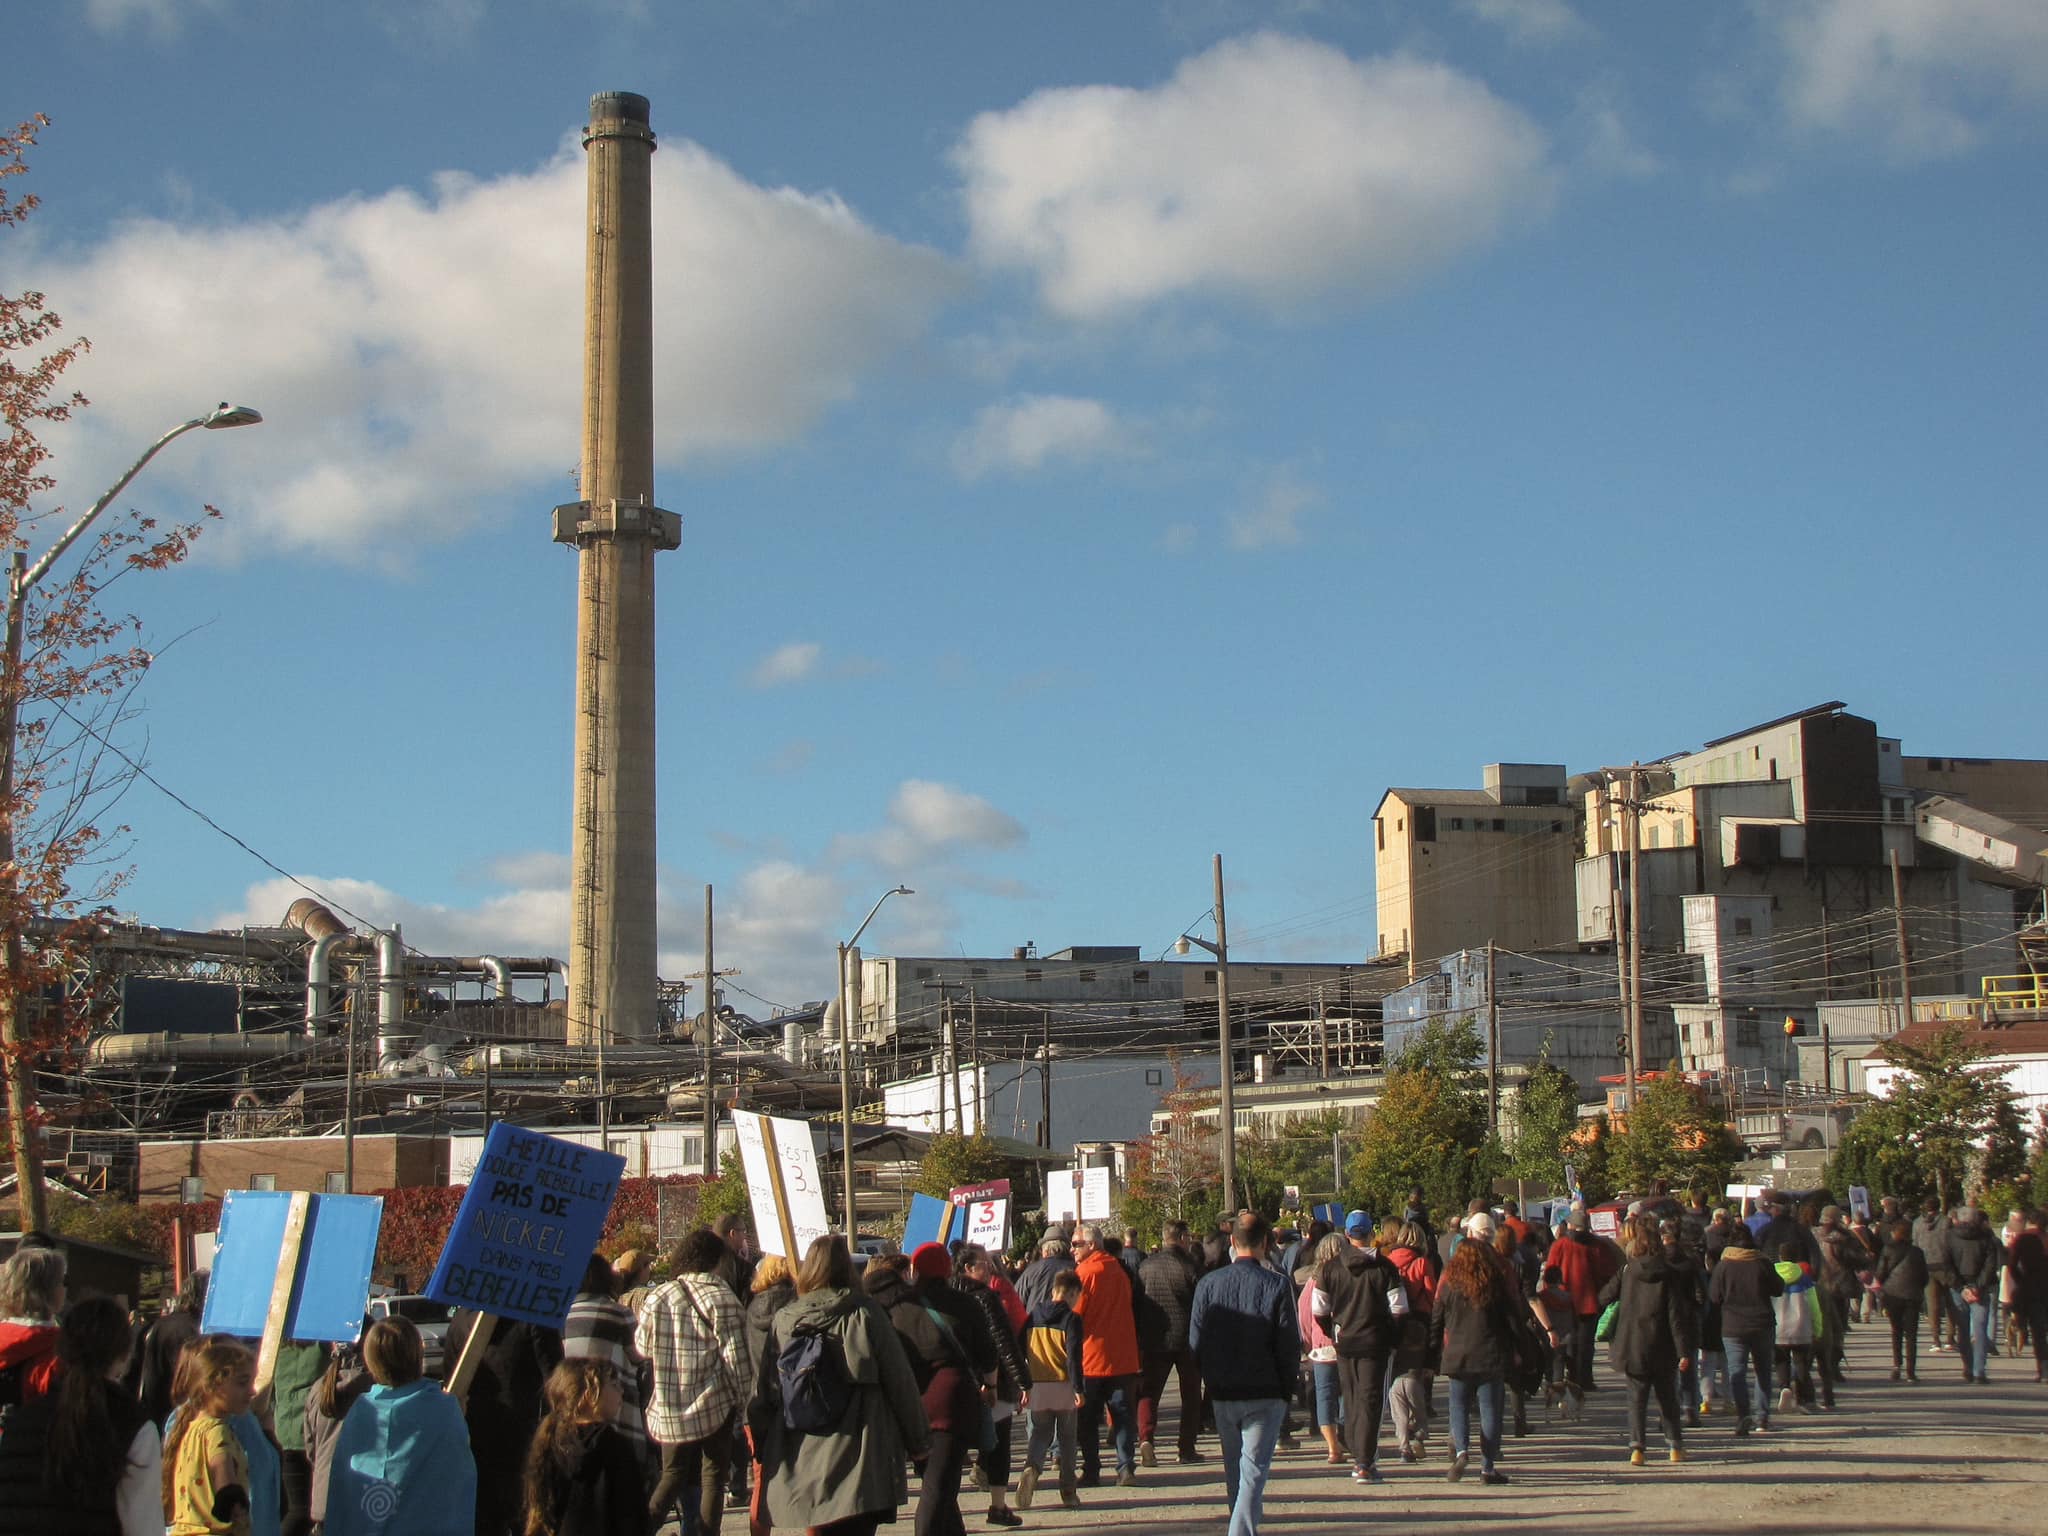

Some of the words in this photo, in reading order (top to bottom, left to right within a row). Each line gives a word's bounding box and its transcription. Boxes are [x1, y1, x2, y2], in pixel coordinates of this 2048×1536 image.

[482, 1154, 528, 1180] DOUCE
[491, 1180, 533, 1208] PAS
[540, 1193, 572, 1218] DE
[979, 1201, 995, 1224] 3
[480, 1247, 521, 1272] DANS
[528, 1260, 561, 1281] MES
